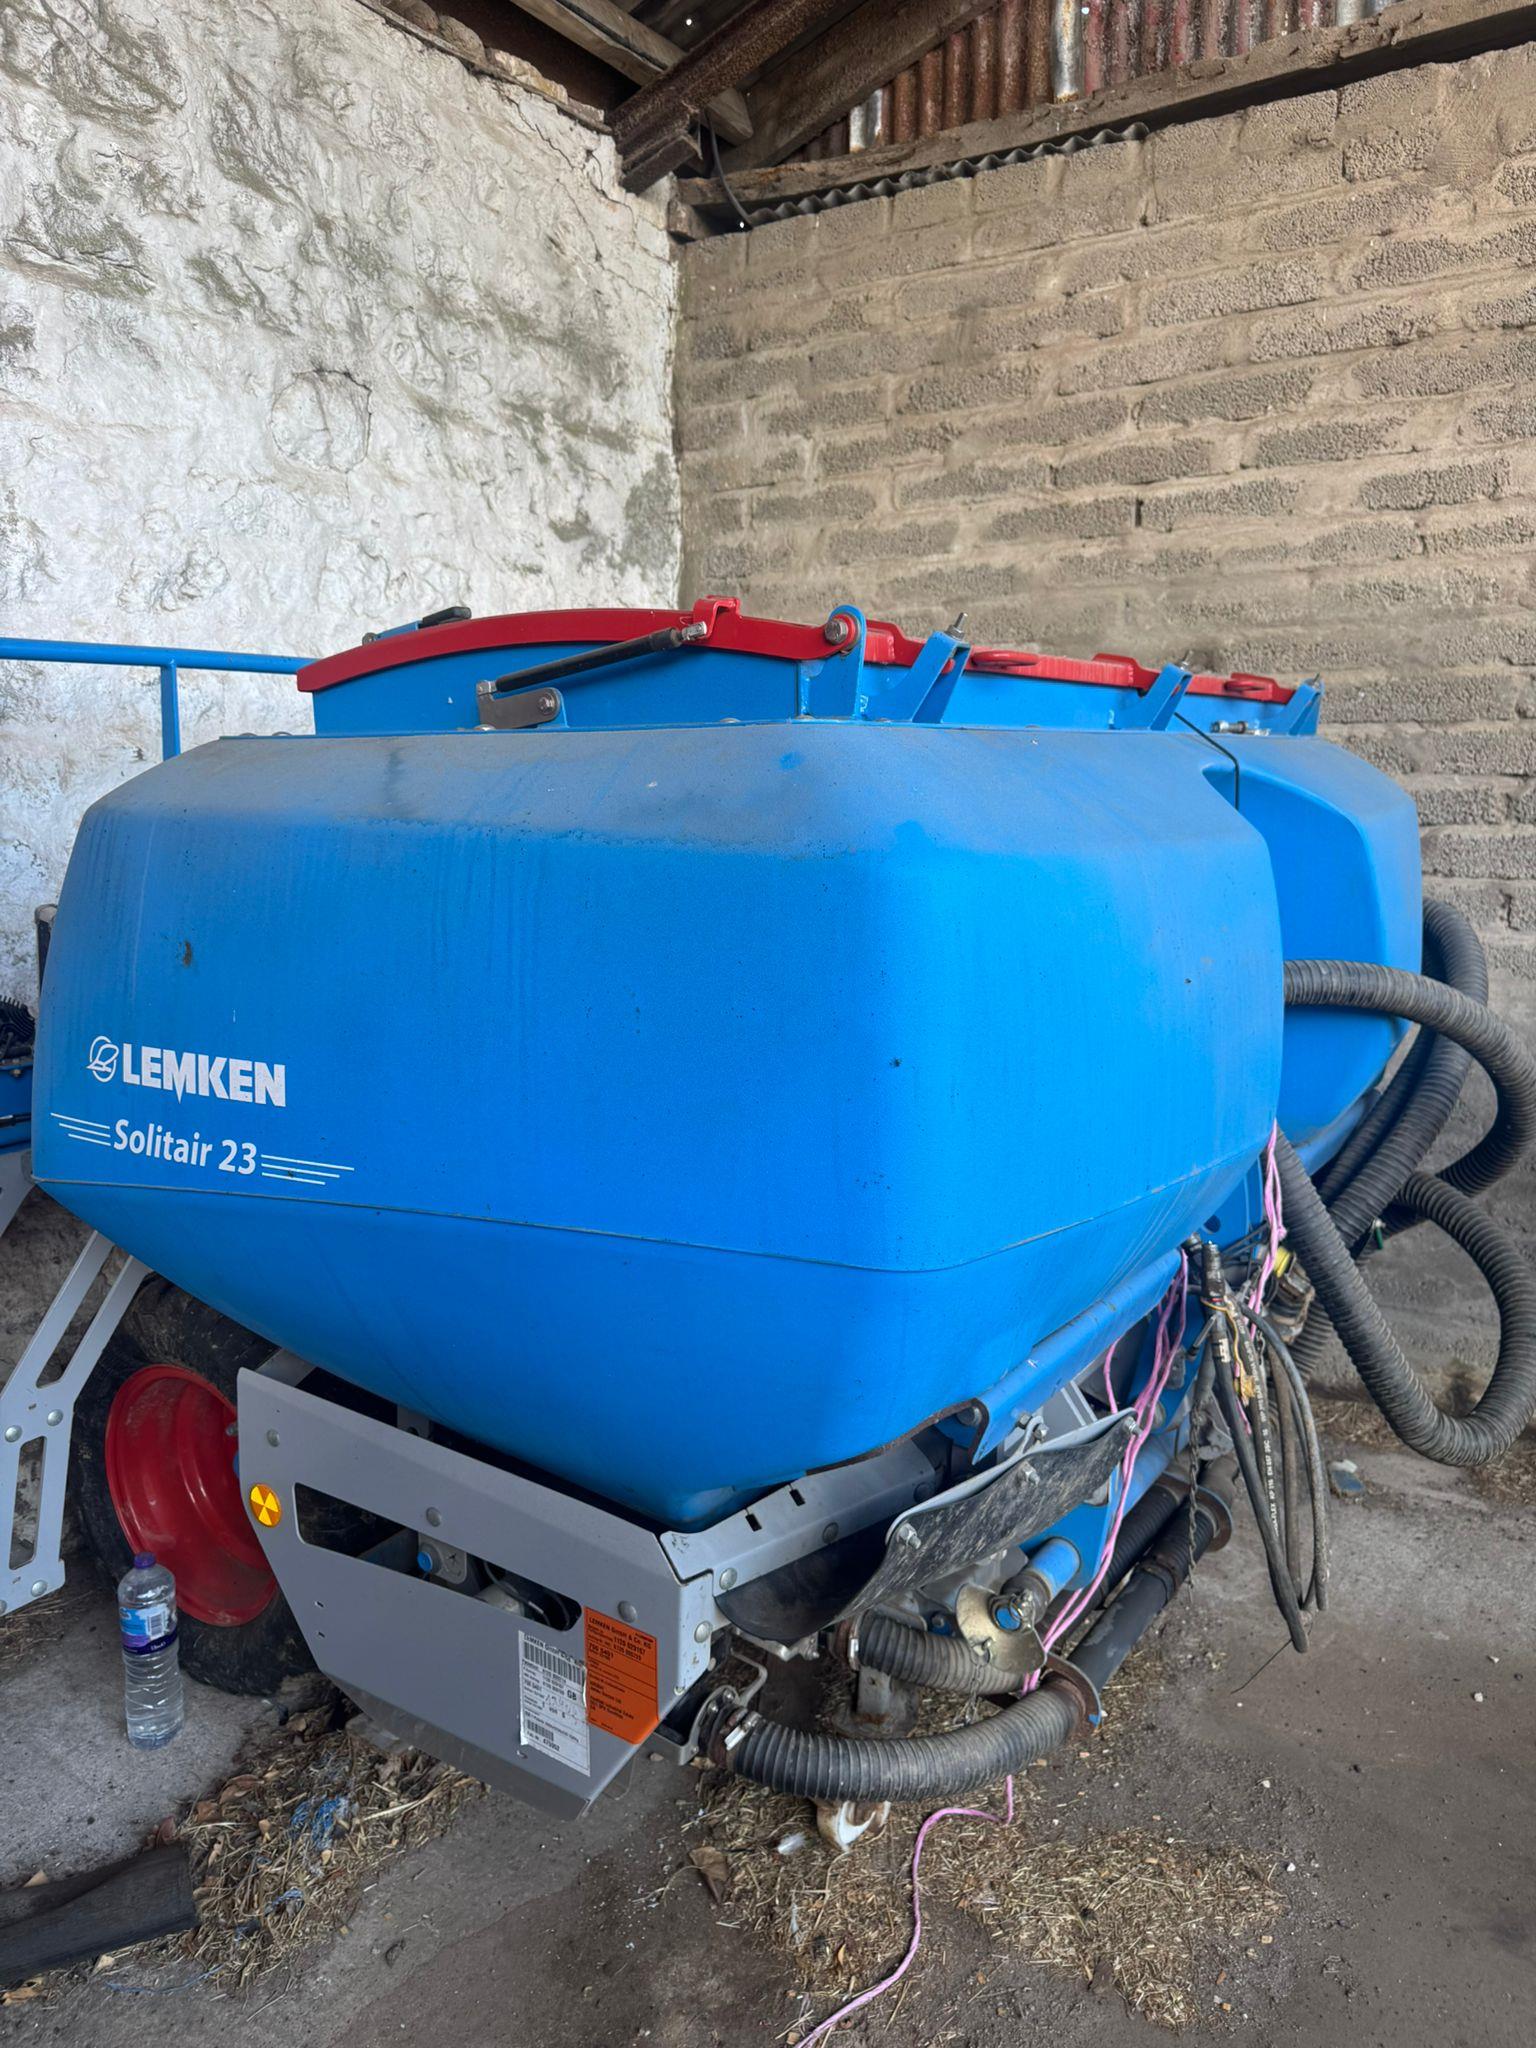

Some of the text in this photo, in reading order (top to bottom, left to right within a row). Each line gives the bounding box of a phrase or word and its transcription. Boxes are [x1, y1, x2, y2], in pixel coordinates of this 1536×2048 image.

[123, 1043, 286, 1107] LEMKEN
[113, 1119, 258, 1175] Solitair 23
